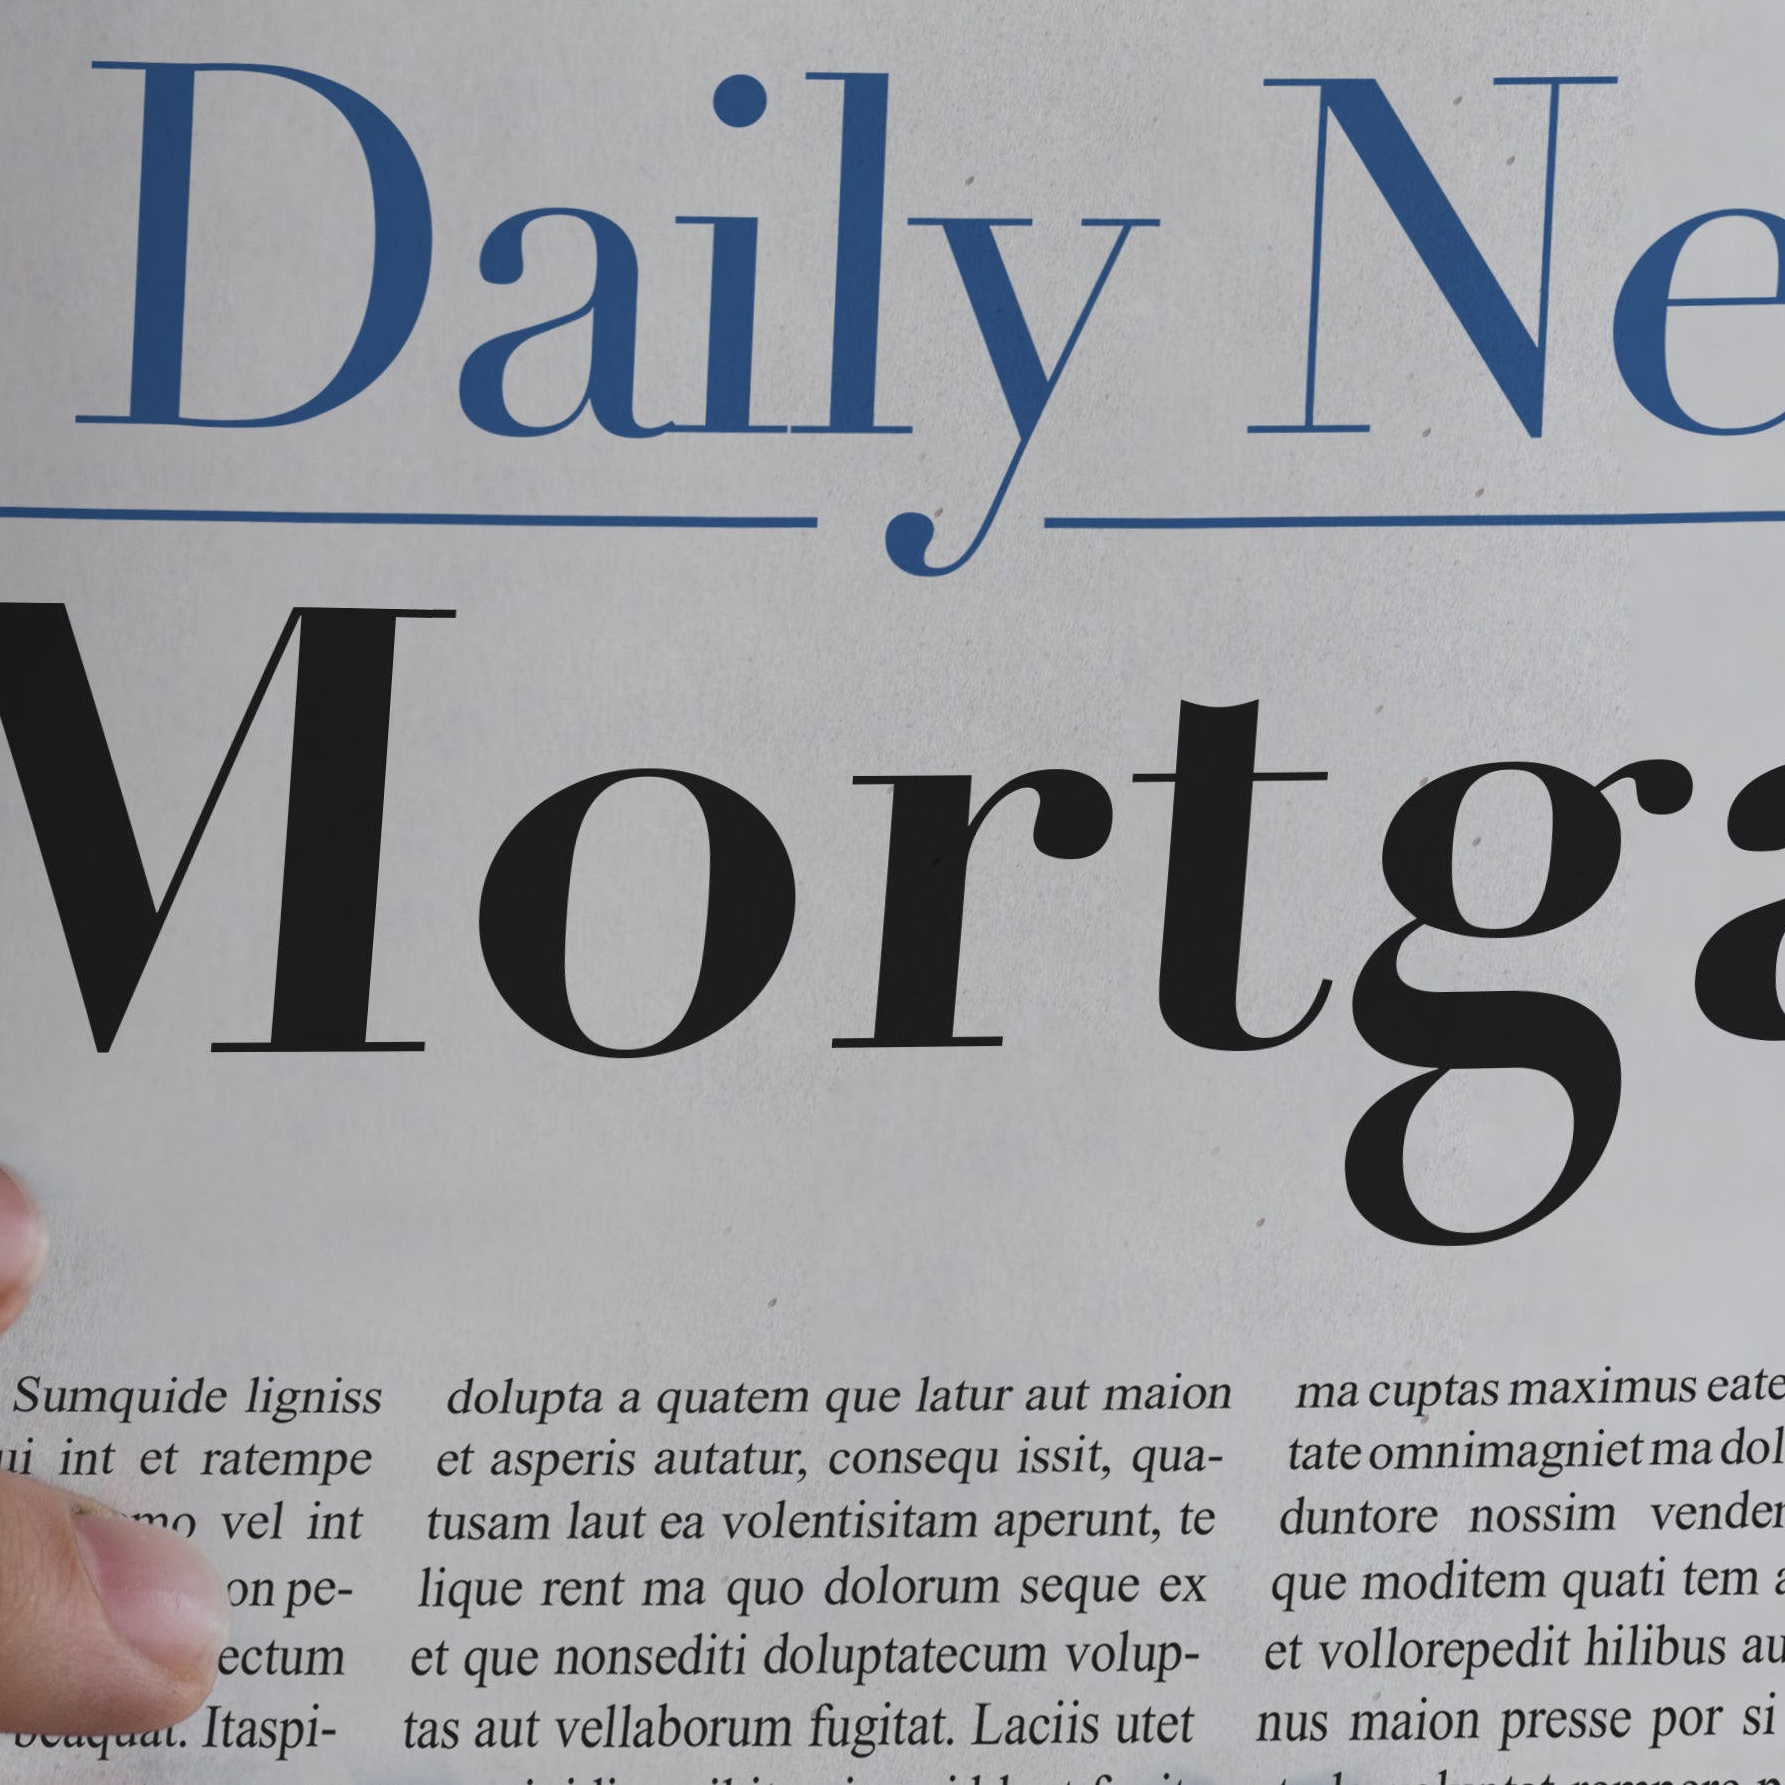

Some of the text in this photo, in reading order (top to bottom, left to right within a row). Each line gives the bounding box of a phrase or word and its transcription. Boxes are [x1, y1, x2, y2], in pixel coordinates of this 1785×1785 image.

[75, 61, 1160, 577] Daily
[13, 1376, 227, 1423] Sumquide
[245, 1376, 382, 1423] ligniss
[447, 1373, 1230, 1424] dolupta a quatem que latur aut maion
[1296, 1382, 1358, 1408] ma
[1369, 1375, 1499, 1417] cuptas
[1508, 1366, 1696, 1405] maximus
[59, 1437, 116, 1475] int
[140, 1443, 179, 1475] et
[201, 1443, 372, 1486] ratempe
[437, 1435, 1222, 1486] et asperis autatur, consequ issit, qua-
[1289, 1438, 1361, 1470] tate
[1369, 1429, 1644, 1478] omnimagniet
[1649, 1439, 1713, 1465] ma
[222, 1501, 283, 1539] vel
[307, 1500, 364, 1539] int
[428, 1499, 1215, 1548] tusam laut ea volentisitam aperunt, te
[1280, 1496, 1438, 1535] duntore
[1469, 1492, 1615, 1532] nossim
[283, 1578, 352, 1618] pe-
[418, 1564, 1206, 1619] lique rent ma quo dolorum seque ex
[1272, 1573, 1346, 1612] que
[1361, 1558, 1546, 1600] moditem
[1563, 1556, 1665, 1609] quati
[1683, 1562, 1758, 1596] tem
[411, 1630, 1199, 1688] et que nonsediti doluptatecum volup-
[1265, 1635, 1303, 1670] et
[1319, 1624, 1571, 1680] vollorepedit
[1585, 1624, 1725, 1665] hilibus
[202, 1703, 336, 1761] Itaspi-
[404, 1700, 1195, 1758] tas aut vellaborum fugitat. Laciis utet
[1256, 1711, 1327, 1741] nus
[1349, 1697, 1479, 1740] maion
[1498, 1708, 1631, 1751] presse
[1649, 1706, 1723, 1749] por
[1743, 1692, 1775, 1735] si
